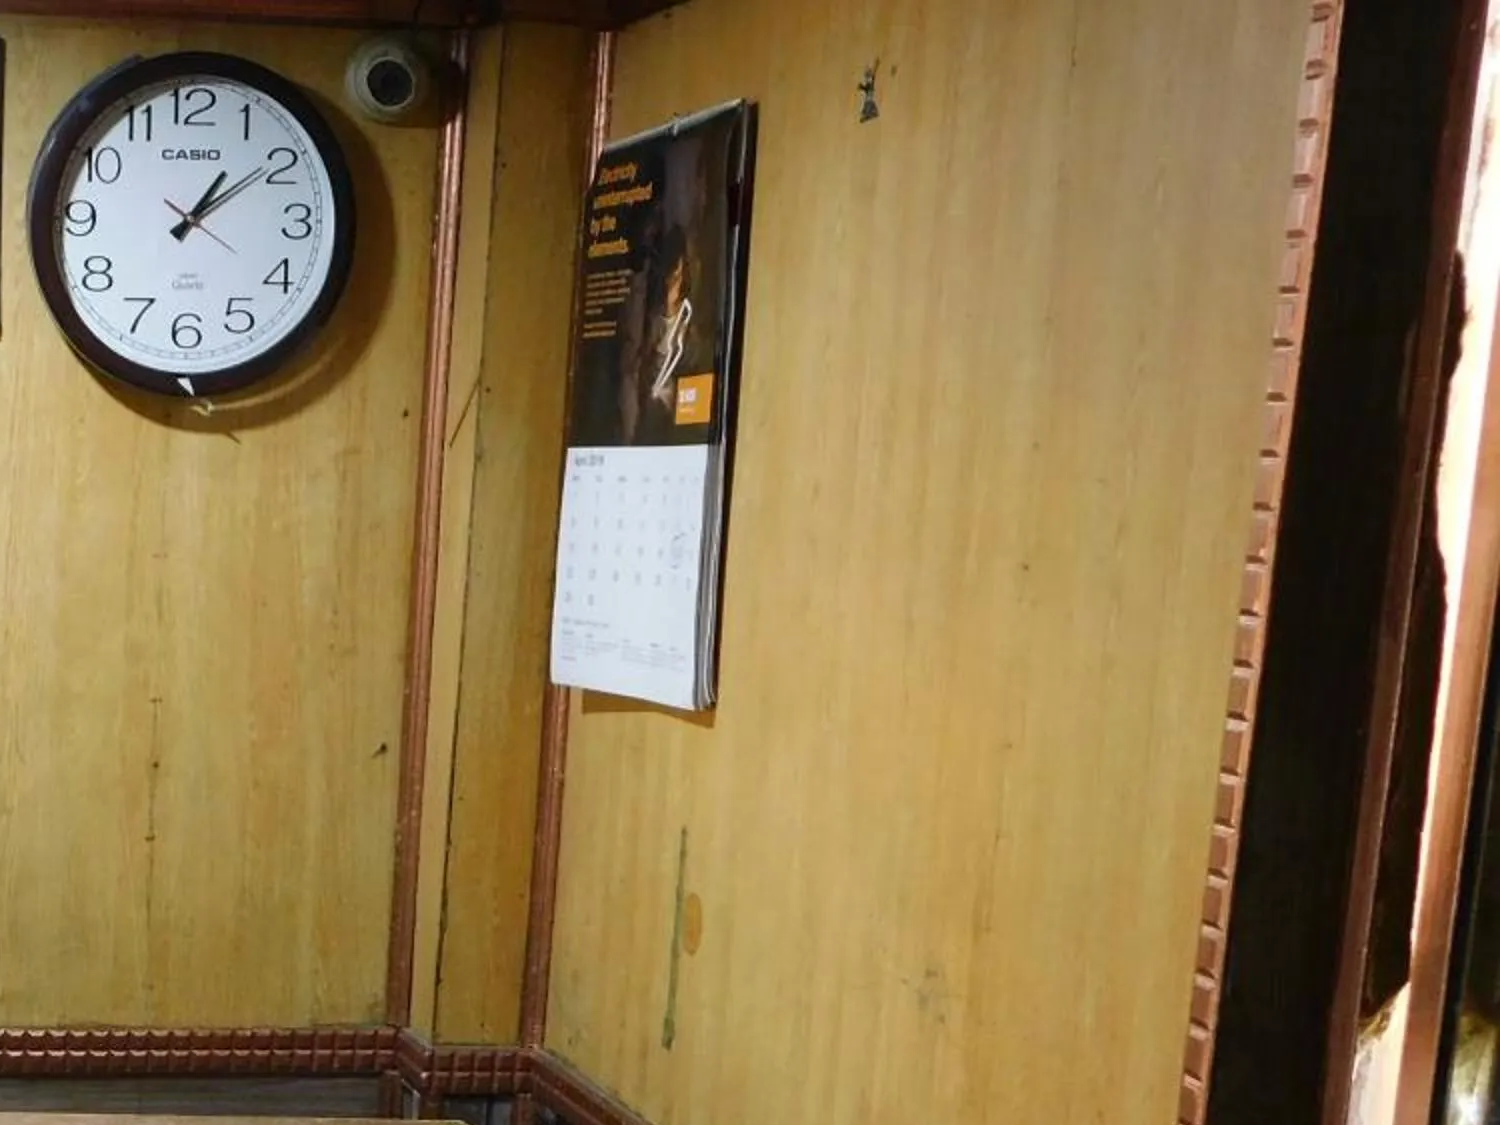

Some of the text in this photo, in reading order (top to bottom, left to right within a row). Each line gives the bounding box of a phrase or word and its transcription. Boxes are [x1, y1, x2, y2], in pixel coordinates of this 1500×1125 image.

[126, 104, 152, 142] 11
[170, 87, 217, 127] 12
[239, 102, 251, 141] 1
[85, 147, 122, 184] 10
[161, 149, 221, 161] CASIO
[265, 147, 299, 185] 2
[65, 199, 97, 237] 9
[281, 203, 313, 240] 3
[82, 255, 114, 293] 8
[261, 257, 295, 295] 4
[123, 297, 157, 335] 7
[170, 313, 203, 350] 6
[223, 297, 256, 335] 5
